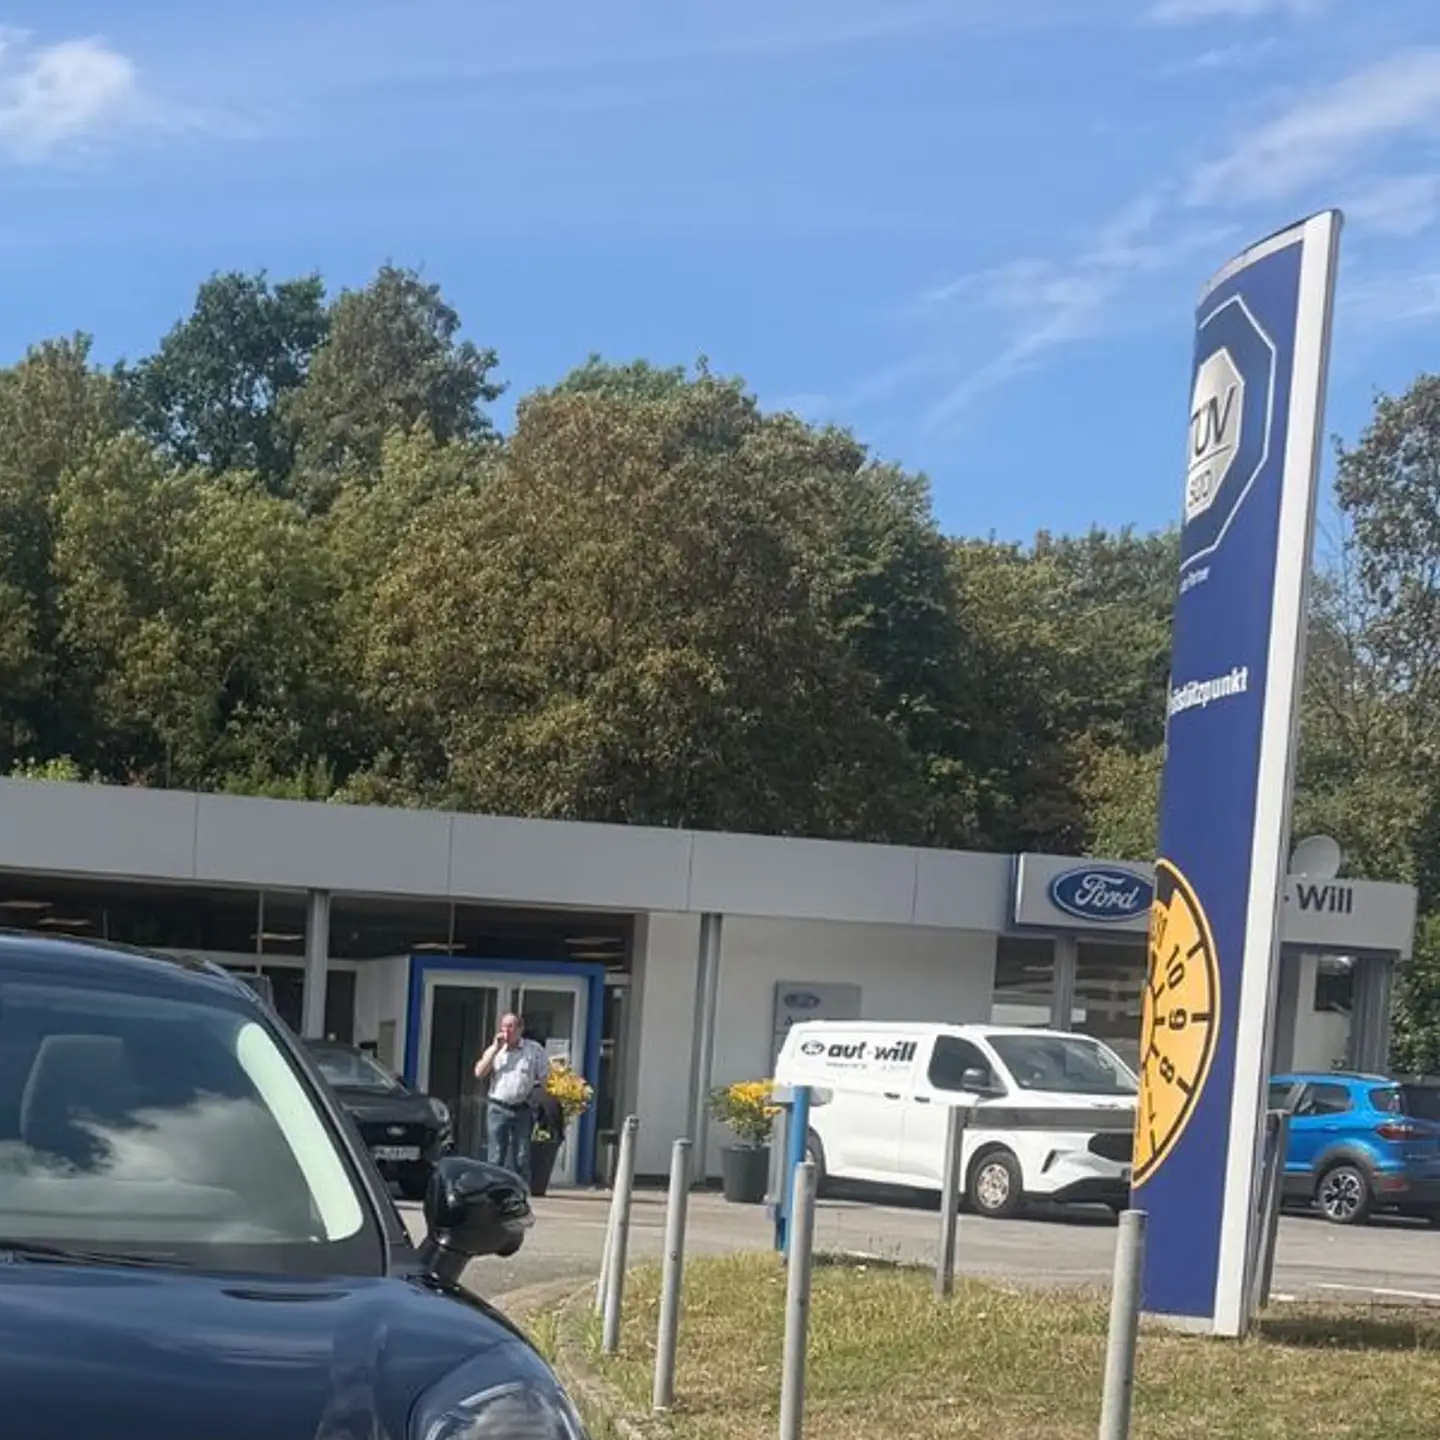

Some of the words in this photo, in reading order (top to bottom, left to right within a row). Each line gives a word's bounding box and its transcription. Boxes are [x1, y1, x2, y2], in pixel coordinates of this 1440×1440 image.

[1074, 873, 1140, 910] Ford
[1296, 883, 1353, 914] Will
[1159, 1056, 1177, 1084] 8
